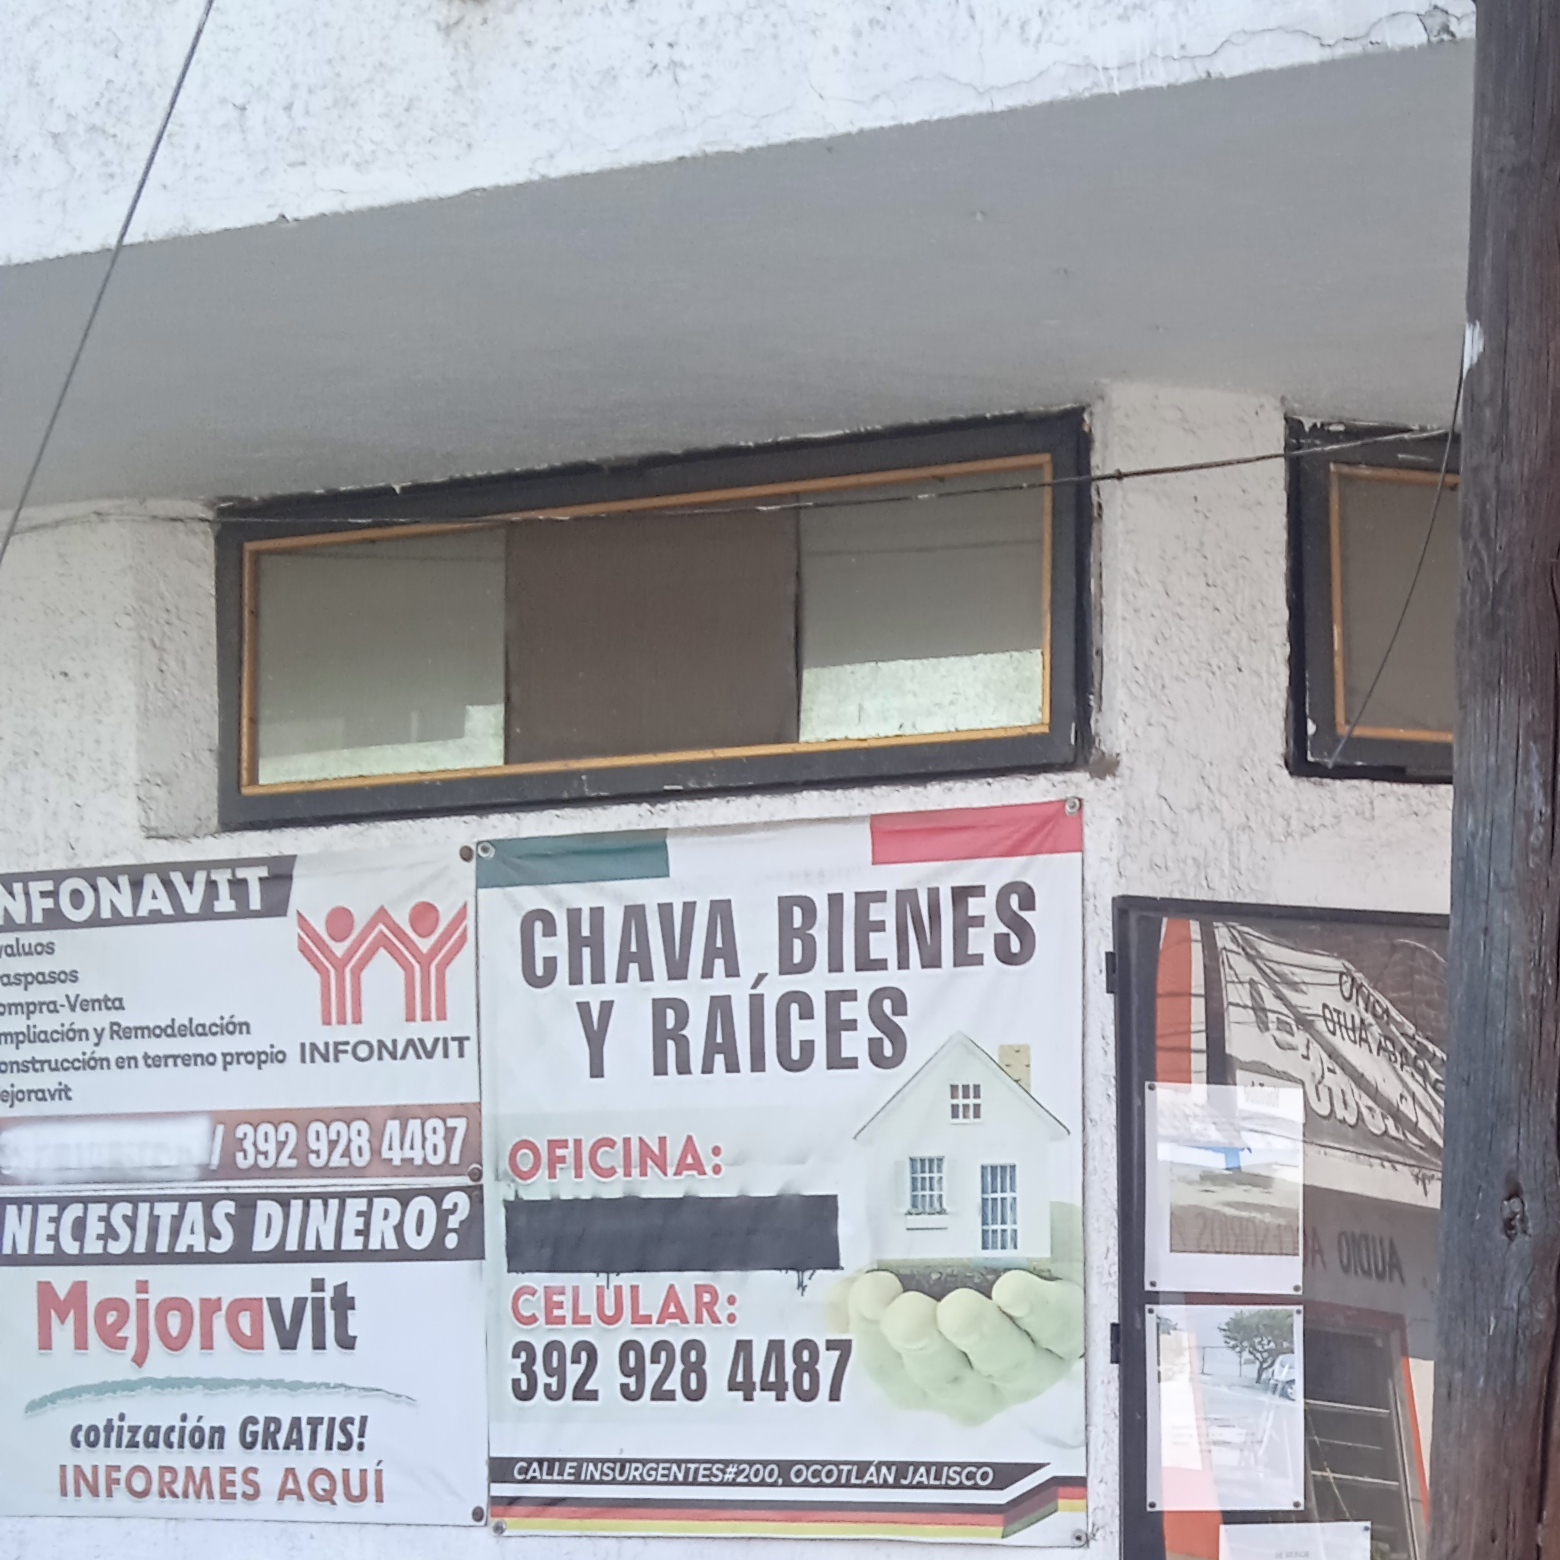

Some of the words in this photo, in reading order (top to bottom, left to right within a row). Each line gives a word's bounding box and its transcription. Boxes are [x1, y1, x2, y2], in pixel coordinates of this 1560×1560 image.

[519, 898, 741, 989] CHAVA
[777, 880, 1037, 976] BIENES
[0, 968, 79, 990] aspasos
[93, 1026, 105, 1047] y
[109, 1014, 252, 1041] Remodelación
[576, 999, 615, 1079] Y
[651, 972, 909, 1078] RAÍCES
[115, 1055, 139, 1070] en
[143, 1050, 217, 1069] terreno
[221, 1044, 287, 1071] propio
[300, 1036, 471, 1065] INFONAVIT
[235, 1123, 298, 1170] 392
[307, 1120, 371, 1169] 928
[381, 1117, 469, 1167] 4487
[507, 1135, 724, 1181] OFICINA:
[2, 1199, 236, 1256] NECESITAS
[251, 1191, 471, 1252] DINERO?
[36, 1278, 358, 1368] Mejoravit
[511, 1283, 738, 1327] CELULAR:
[511, 1339, 599, 1403] 392
[618, 1339, 708, 1403] 928
[727, 1339, 853, 1403] 4487
[69, 1412, 226, 1450] cotización
[239, 1415, 369, 1451] GRATIS!
[58, 1464, 261, 1502] INFORMES
[277, 1460, 385, 1506] AQUÍ
[513, 1460, 579, 1481] CALLE
[580, 1461, 783, 1487] INSURGENTES#200,
[790, 1458, 897, 1486] OCOTLÁN
[900, 1465, 994, 1487] JALISCO
